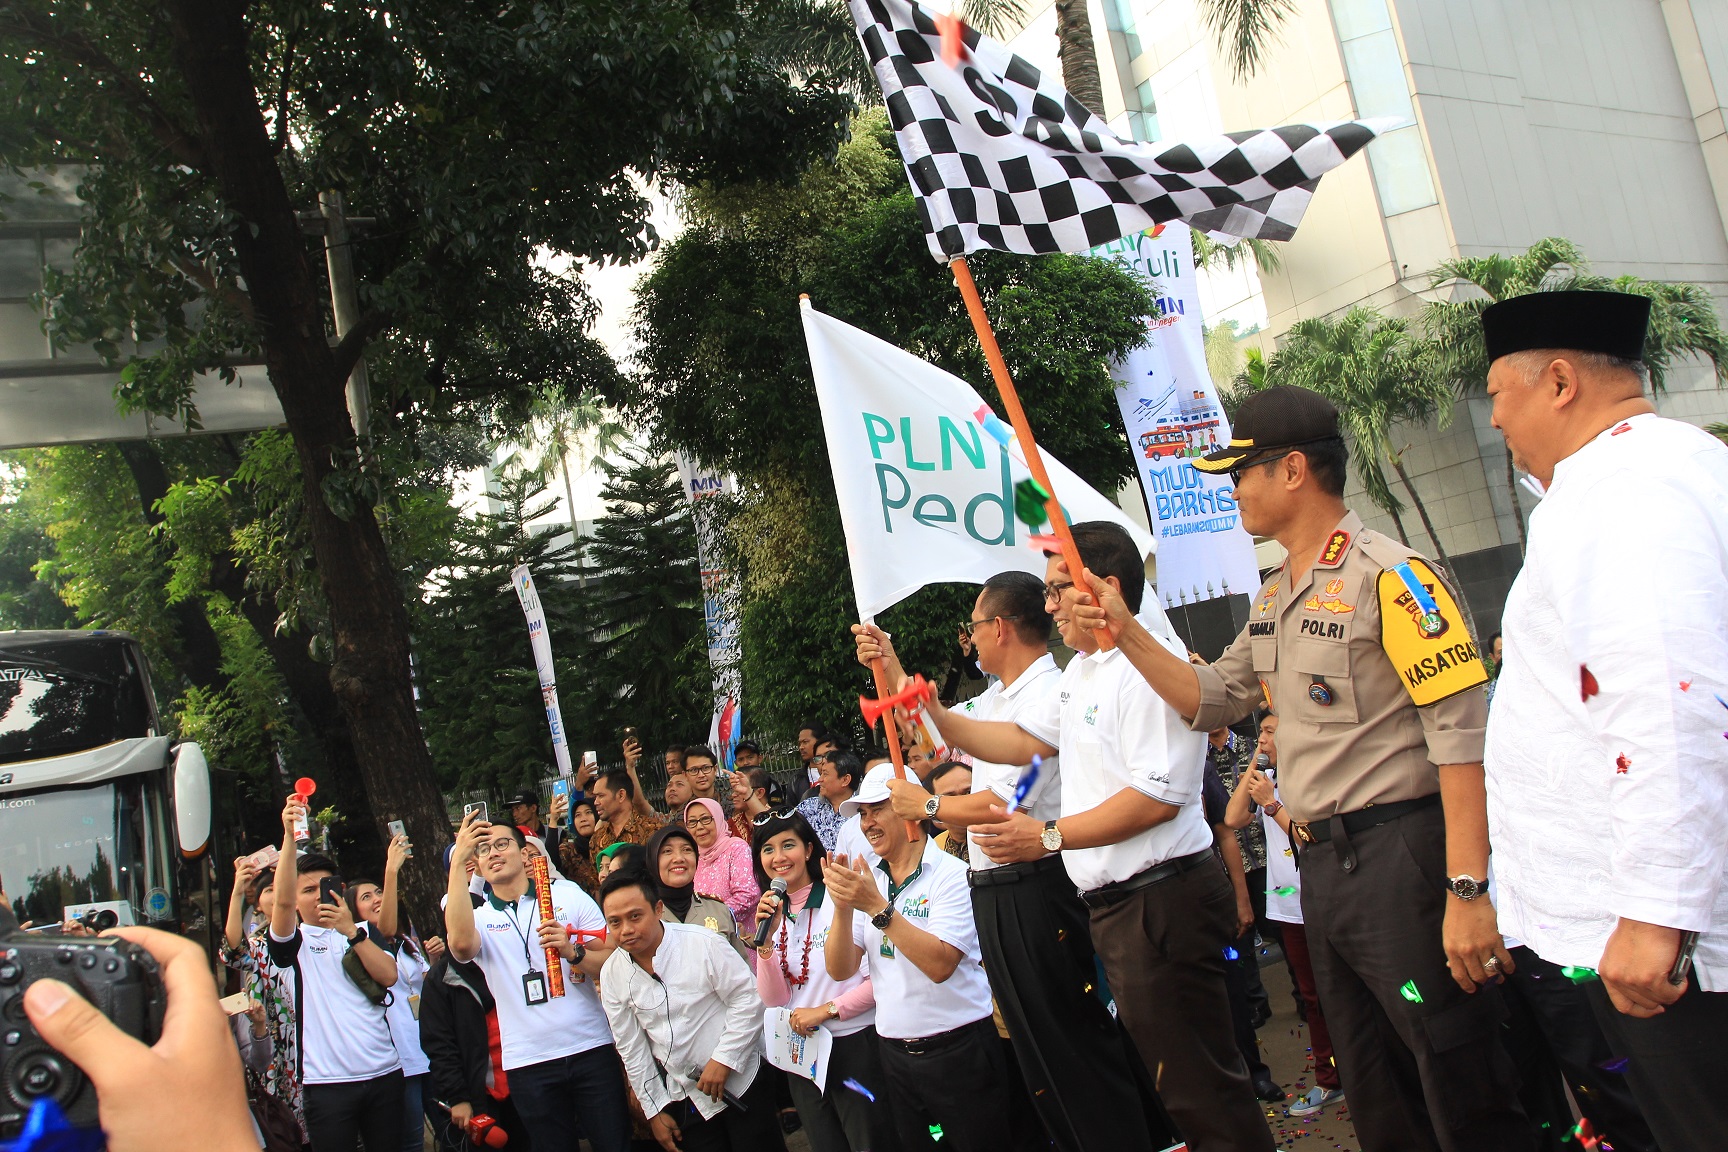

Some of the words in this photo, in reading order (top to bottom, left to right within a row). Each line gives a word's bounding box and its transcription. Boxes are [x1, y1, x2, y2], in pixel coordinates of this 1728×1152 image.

[862, 412, 986, 472] PLN
[874, 447, 1045, 547] Ped
[1300, 618, 1345, 640] POLRI
[0, 772, 14, 785] a
[904, 898, 919, 907] PLN
[902, 905, 930, 918] Peduli
[811, 939, 825, 950] Ped
